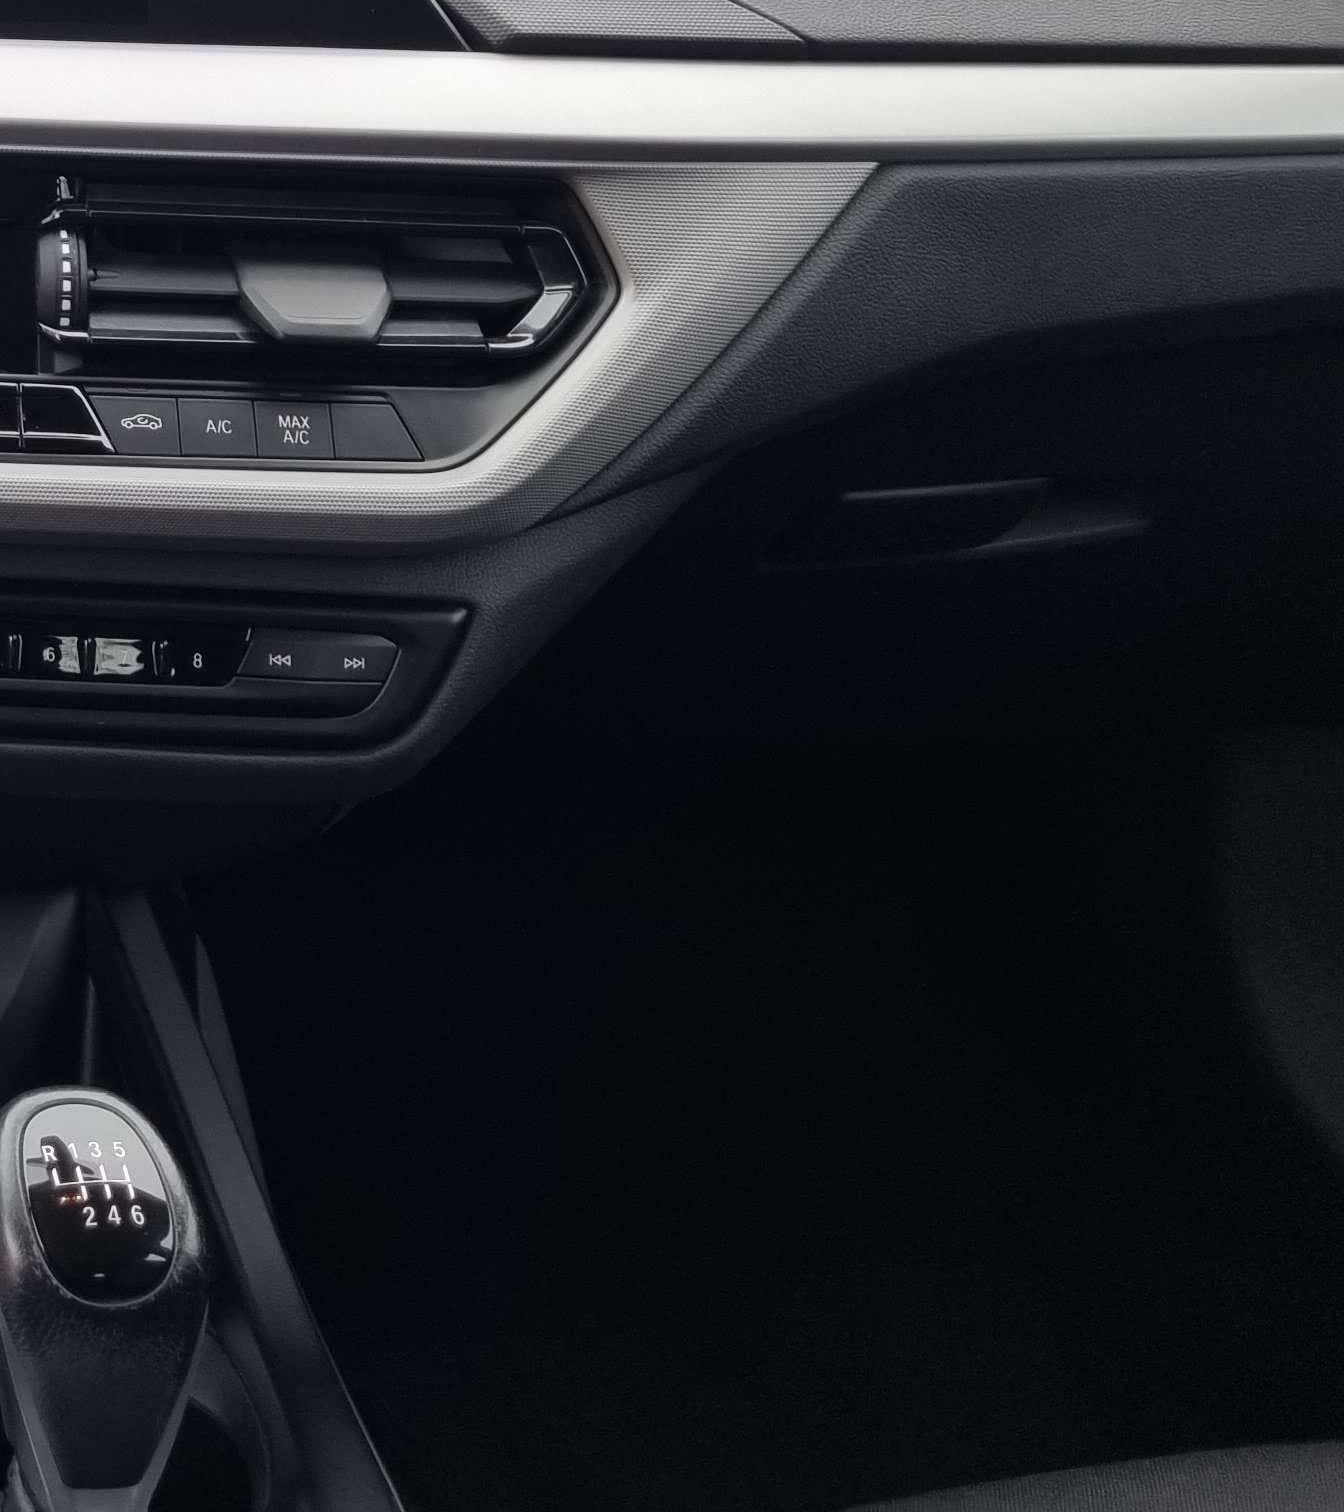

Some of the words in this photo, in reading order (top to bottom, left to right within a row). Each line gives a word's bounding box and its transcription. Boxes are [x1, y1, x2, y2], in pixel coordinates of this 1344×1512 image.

[206, 419, 233, 434] A/C
[278, 414, 311, 429] MAX
[283, 429, 310, 445] A/C
[192, 652, 203, 669] 8
[41, 1144, 58, 1162] R
[67, 1142, 79, 1159] 1
[88, 1141, 102, 1158] 3
[111, 1141, 126, 1159] 5
[82, 1206, 98, 1227] 2
[107, 1204, 122, 1225] 4
[130, 1204, 145, 1226] 6
